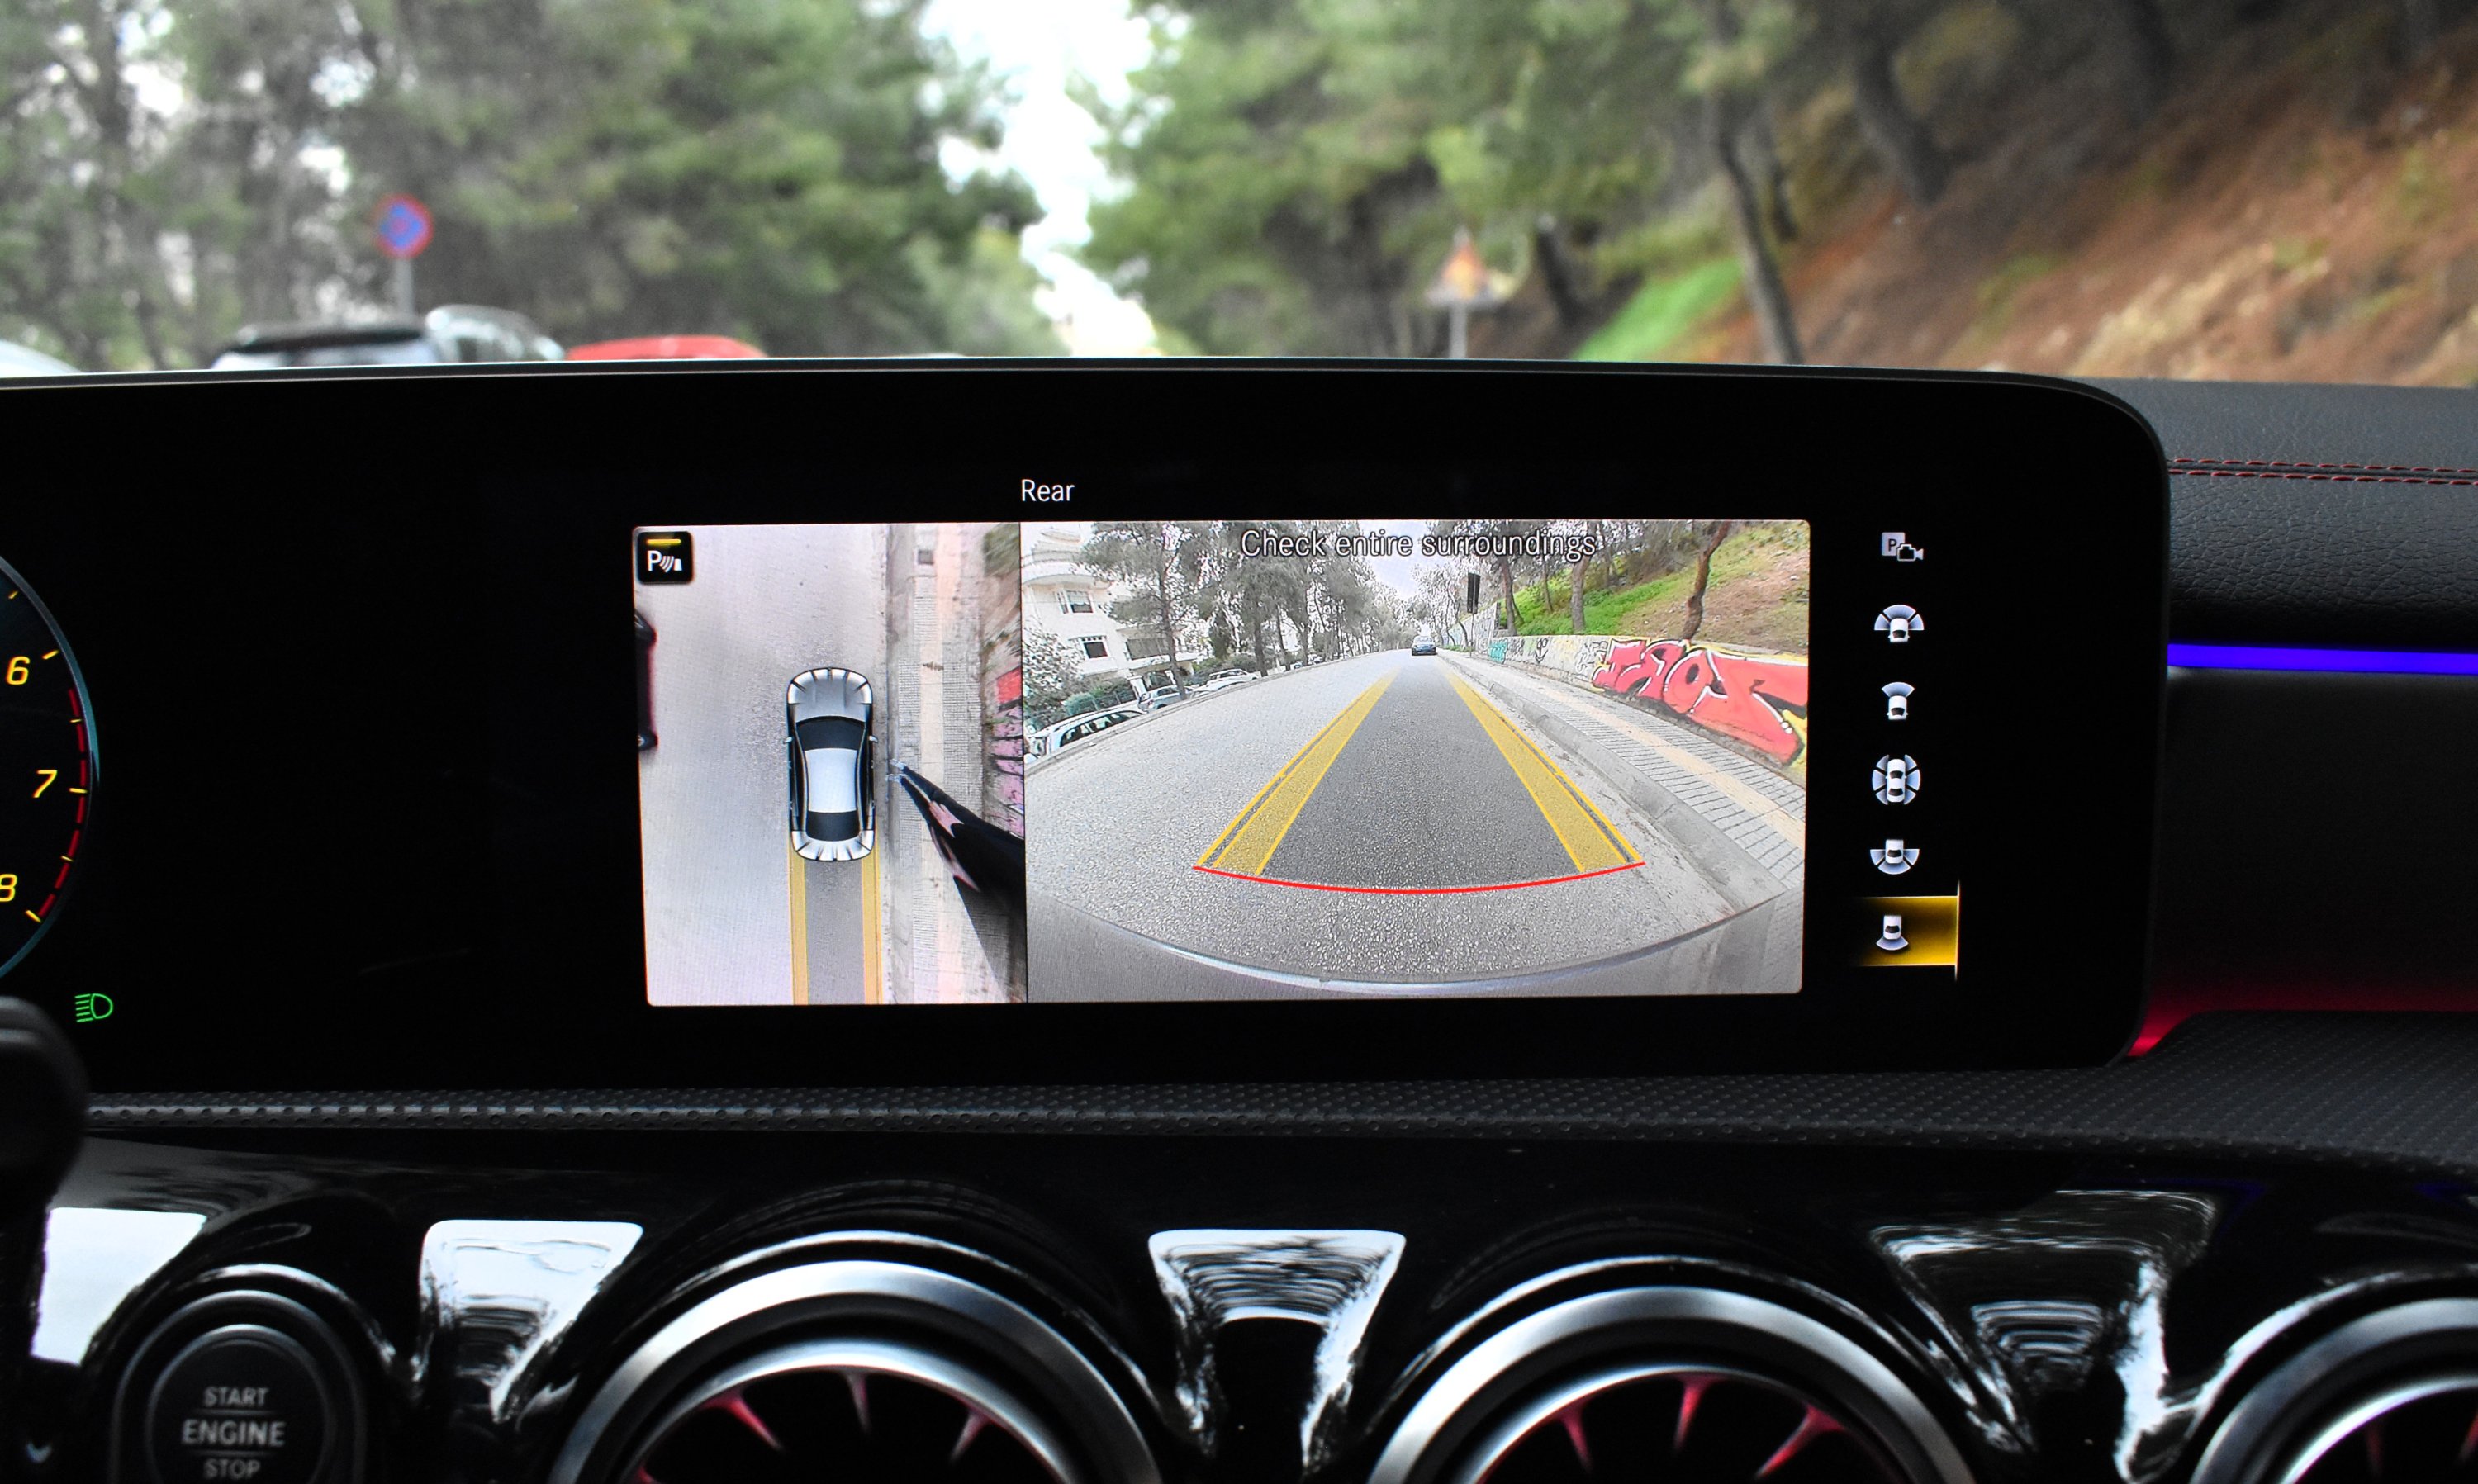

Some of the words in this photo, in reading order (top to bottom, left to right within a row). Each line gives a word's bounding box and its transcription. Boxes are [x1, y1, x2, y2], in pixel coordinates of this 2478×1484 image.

[1021, 478, 1075, 502] Rear
[1241, 529, 1326, 557] Check
[1335, 529, 1413, 557] entire
[1422, 529, 1598, 563] surroundings
[1888, 538, 1897, 552] P
[647, 549, 662, 571] P
[5, 656, 31, 685] 6
[33, 769, 58, 799] 7
[0, 873, 17, 903] 8
[204, 1386, 269, 1406] START
[182, 1419, 286, 1446] ENGINE
[204, 1458, 261, 1478] STOP
